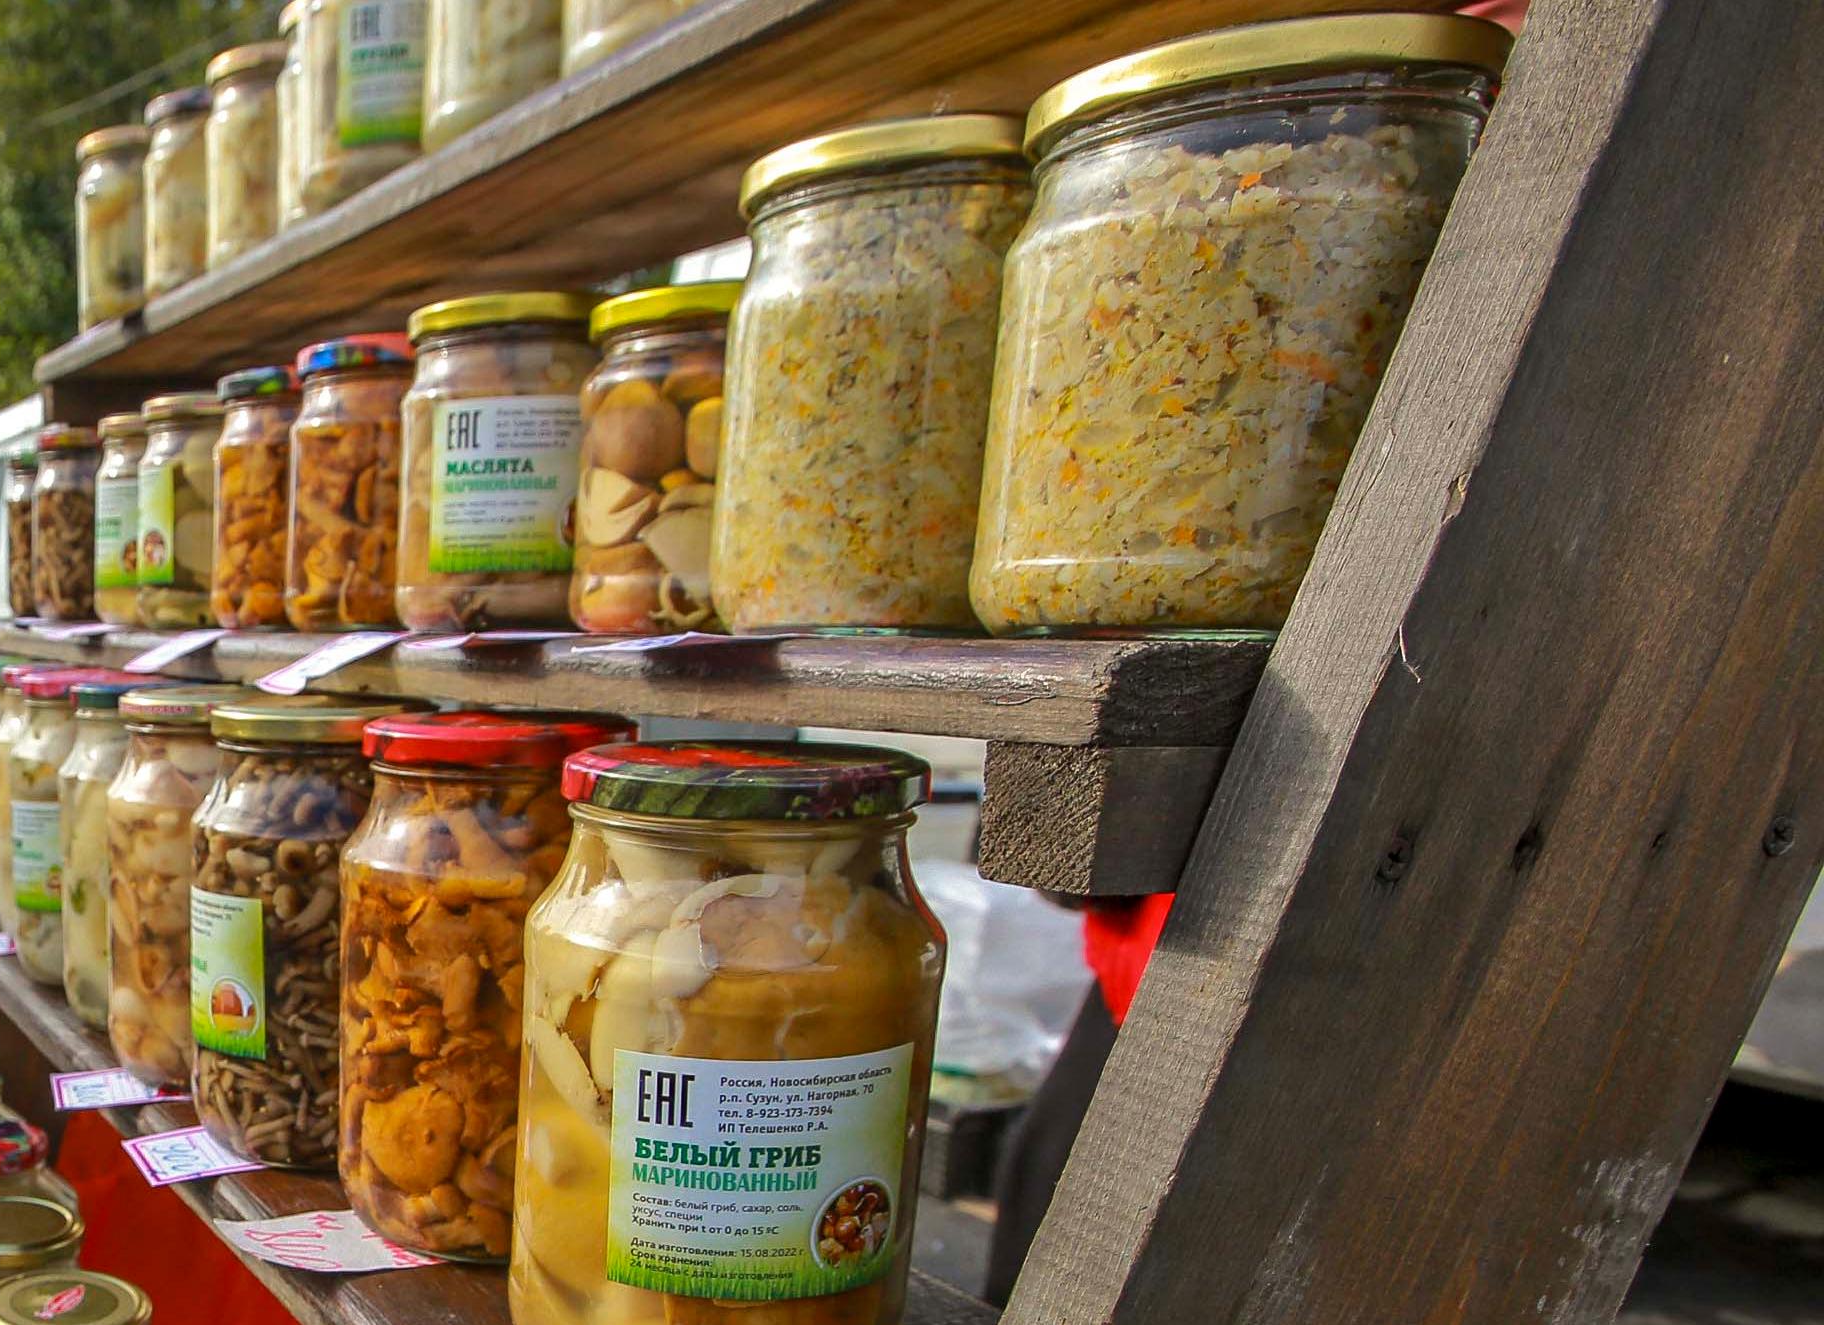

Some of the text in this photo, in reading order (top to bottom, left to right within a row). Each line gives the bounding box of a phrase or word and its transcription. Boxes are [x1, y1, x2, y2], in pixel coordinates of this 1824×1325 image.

[446, 458, 534, 475] МАСЛЯТА
[720, 1065, 893, 1088] Россия, Новосибирская область
[719, 1094, 742, 1105] р.п.
[746, 1093, 783, 1106] Сузун,
[786, 1093, 804, 1105] ул.
[863, 1084, 874, 1095] 70
[718, 1106, 833, 1118] тел. 8-923-173-7394
[718, 1122, 829, 1134] ИП Телешенко Р.А.
[634, 1137, 822, 1169] БЕЛЫЙ ГРИБ
[632, 1162, 818, 1193] МАРИНОВАННЫЙ
[632, 1193, 672, 1207] Состав:
[674, 1198, 709, 1211] белый
[711, 1202, 740, 1214] гриб,
[742, 1205, 775, 1214] сахар,
[632, 1205, 703, 1222] уксус, специи
[632, 1215, 676, 1230] Хранить
[678, 1223, 699, 1234] при
[701, 1225, 706, 1233] t
[709, 1226, 722, 1234] от
[725, 1226, 732, 1234] 0
[734, 1228, 749, 1236] до
[752, 1226, 763, 1235] 15
[631, 1237, 656, 1250] Дата
[658, 1243, 737, 1257] изготовления:
[630, 1248, 713, 1267] Срок хранения:
